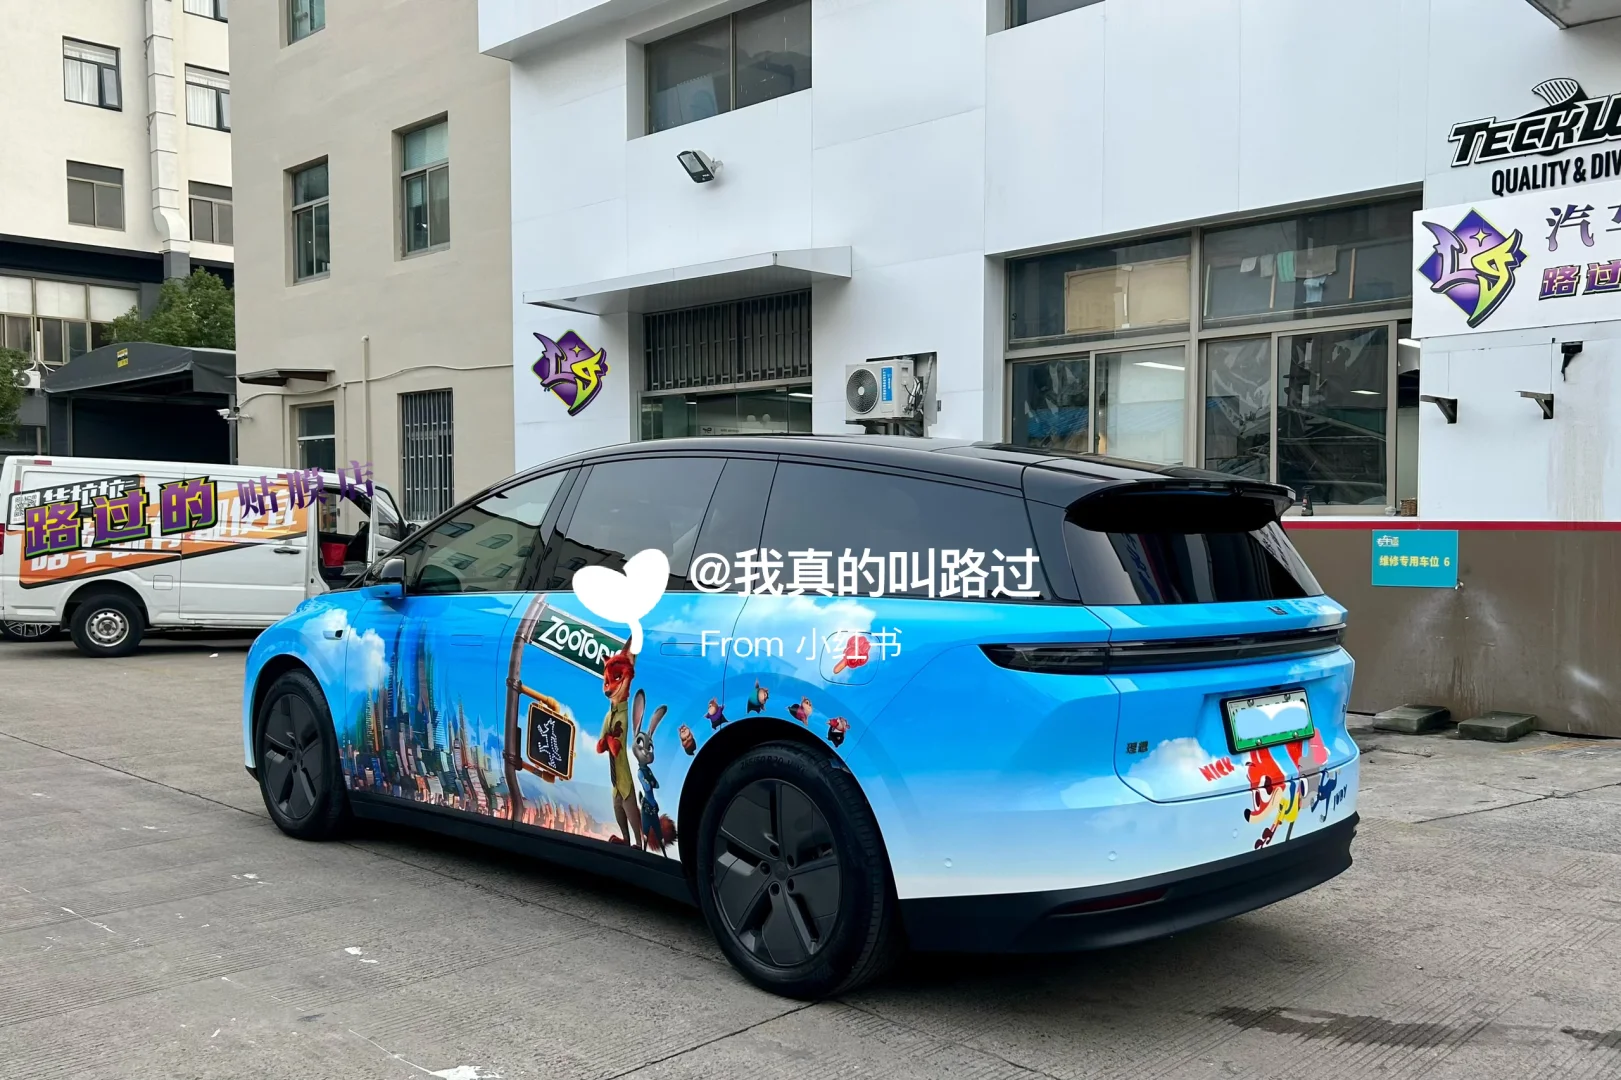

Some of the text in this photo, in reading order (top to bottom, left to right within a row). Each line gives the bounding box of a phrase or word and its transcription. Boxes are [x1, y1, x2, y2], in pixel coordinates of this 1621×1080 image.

[1492, 149, 1621, 196] QUALITY & DIV
[1539, 259, 1621, 301] 路过
[1443, 557, 1450, 567] 6
[538, 615, 622, 665] ZOOTOP
[1199, 757, 1234, 781] NICK
